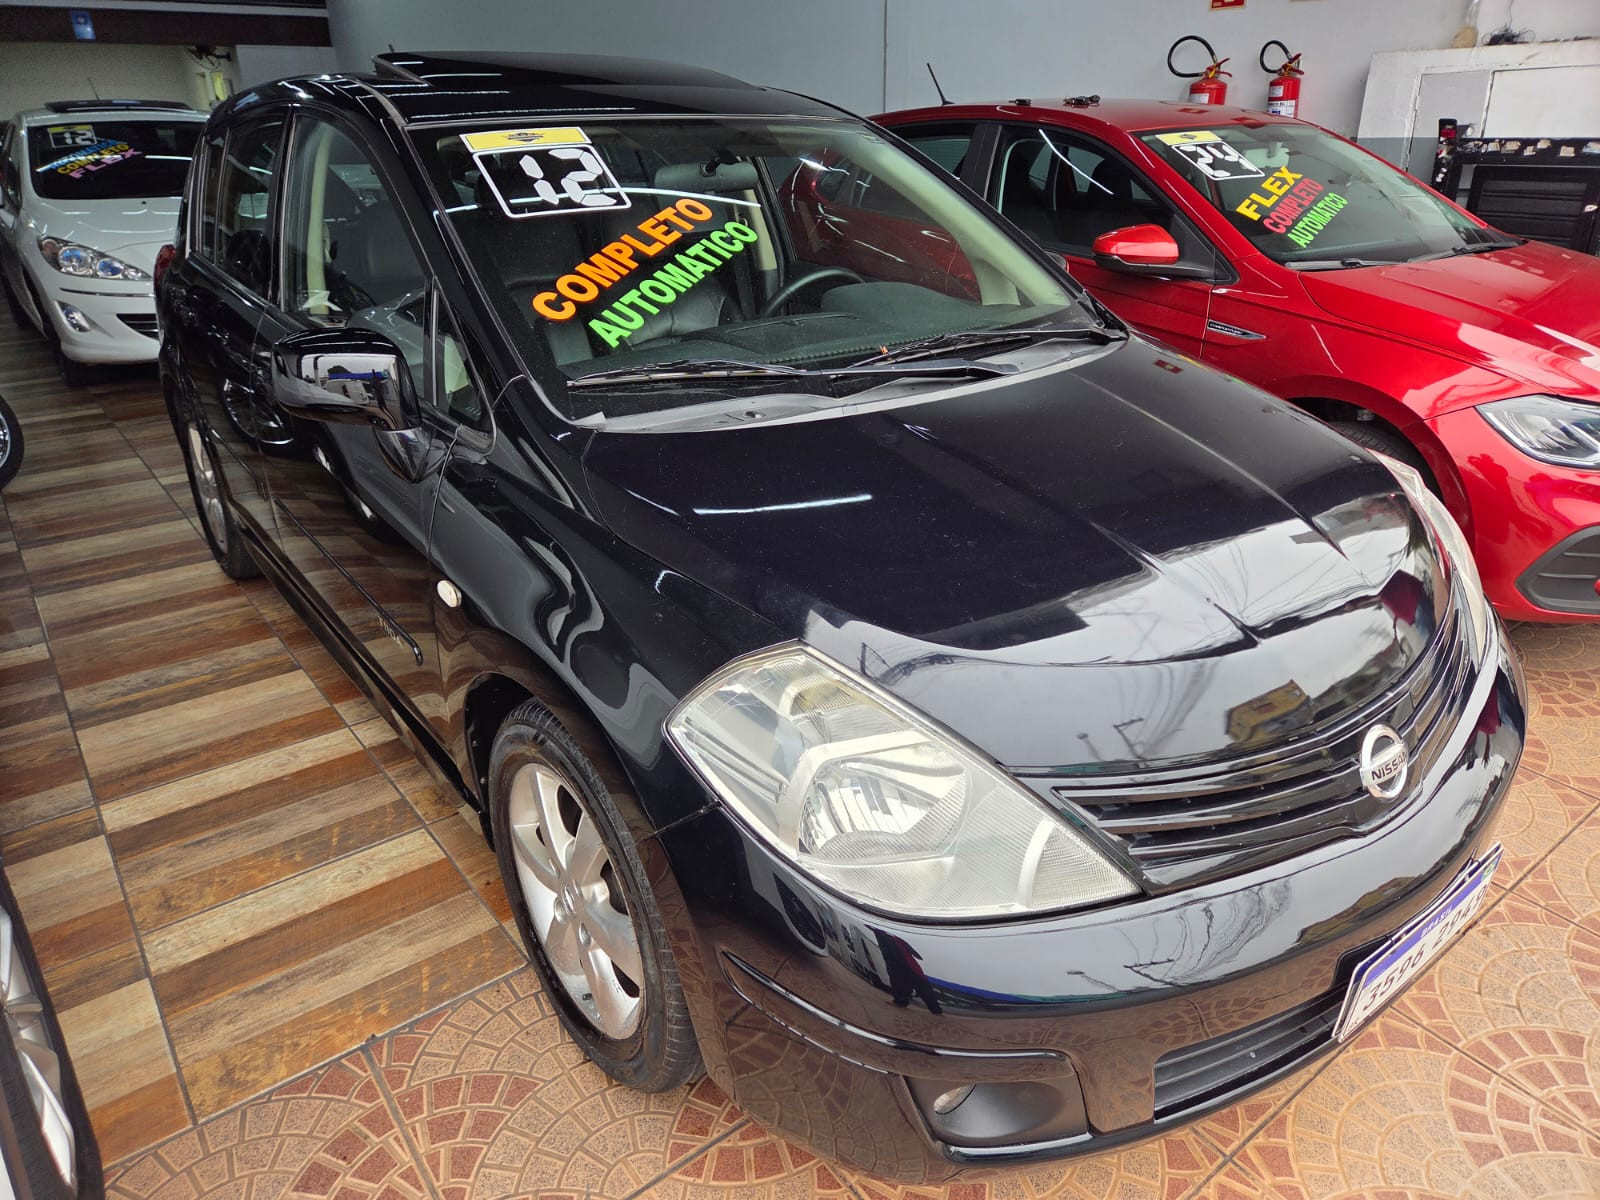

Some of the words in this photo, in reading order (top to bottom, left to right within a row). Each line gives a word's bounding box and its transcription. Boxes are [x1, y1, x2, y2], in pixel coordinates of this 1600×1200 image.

[64, 130, 92, 145] 12
[68, 148, 142, 179] FLEX
[1179, 143, 1257, 178] 24
[519, 149, 617, 206] 12
[1236, 166, 1302, 221] FLEX
[1263, 177, 1324, 234] COMPLETO
[1287, 192, 1348, 249] AUTOMATICO
[532, 198, 713, 321] COMPLETO
[588, 221, 758, 348] AUTOMATICO
[1371, 751, 1407, 781] NISSAN
[1362, 943, 1426, 1012] 3596
